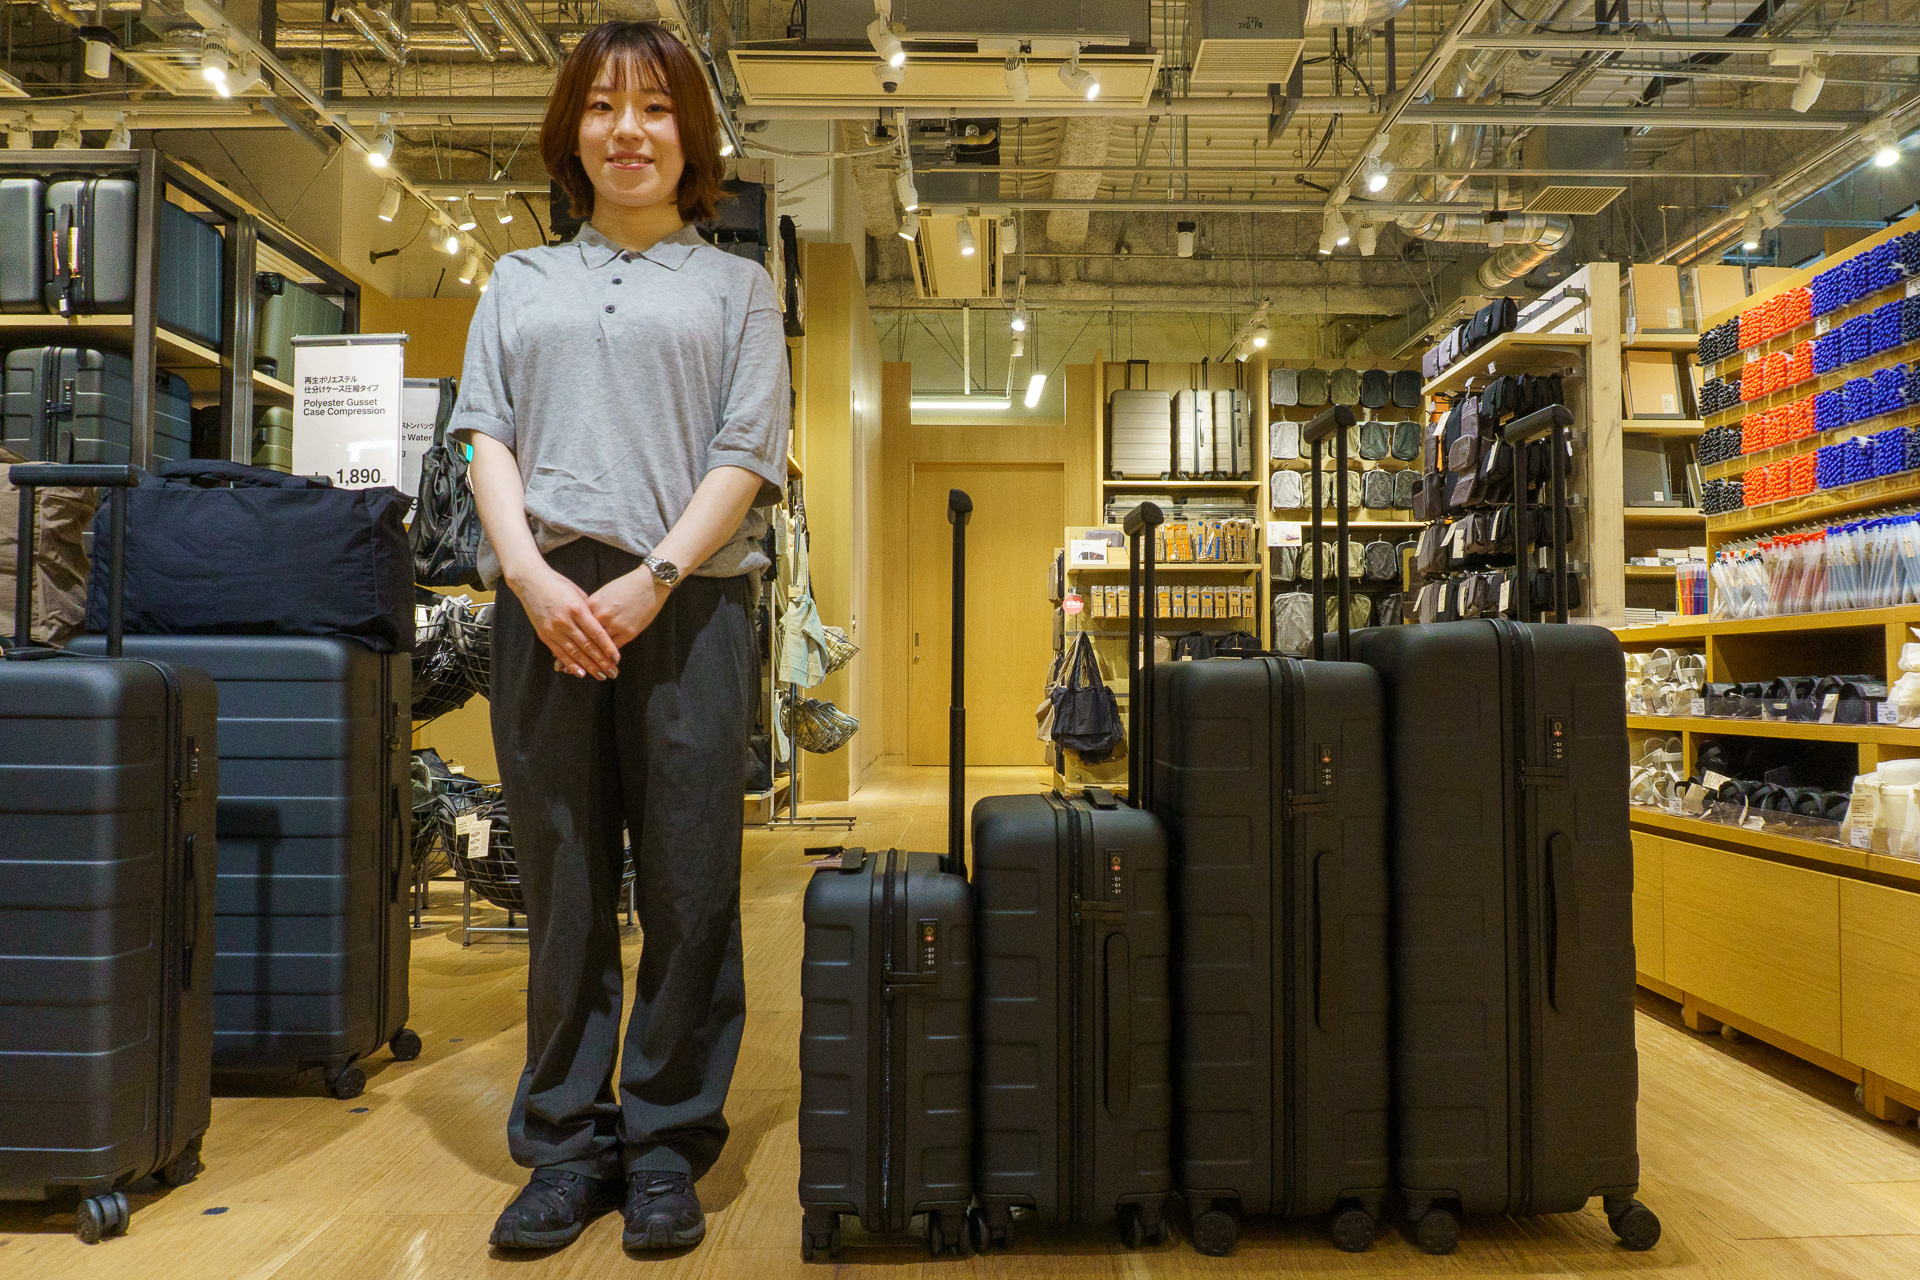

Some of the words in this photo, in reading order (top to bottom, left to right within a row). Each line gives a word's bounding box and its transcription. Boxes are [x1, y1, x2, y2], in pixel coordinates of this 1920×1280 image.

[304, 376, 358, 385] 再生ポリエステル
[304, 384, 379, 394] 仕分けケース圧縮タイプ
[303, 399, 345, 409] Polyester
[346, 398, 378, 406] Gusset
[303, 407, 326, 416] Case
[327, 406, 386, 417] Compression
[407, 433, 433, 441] Water
[336, 468, 381, 486] 1,890
